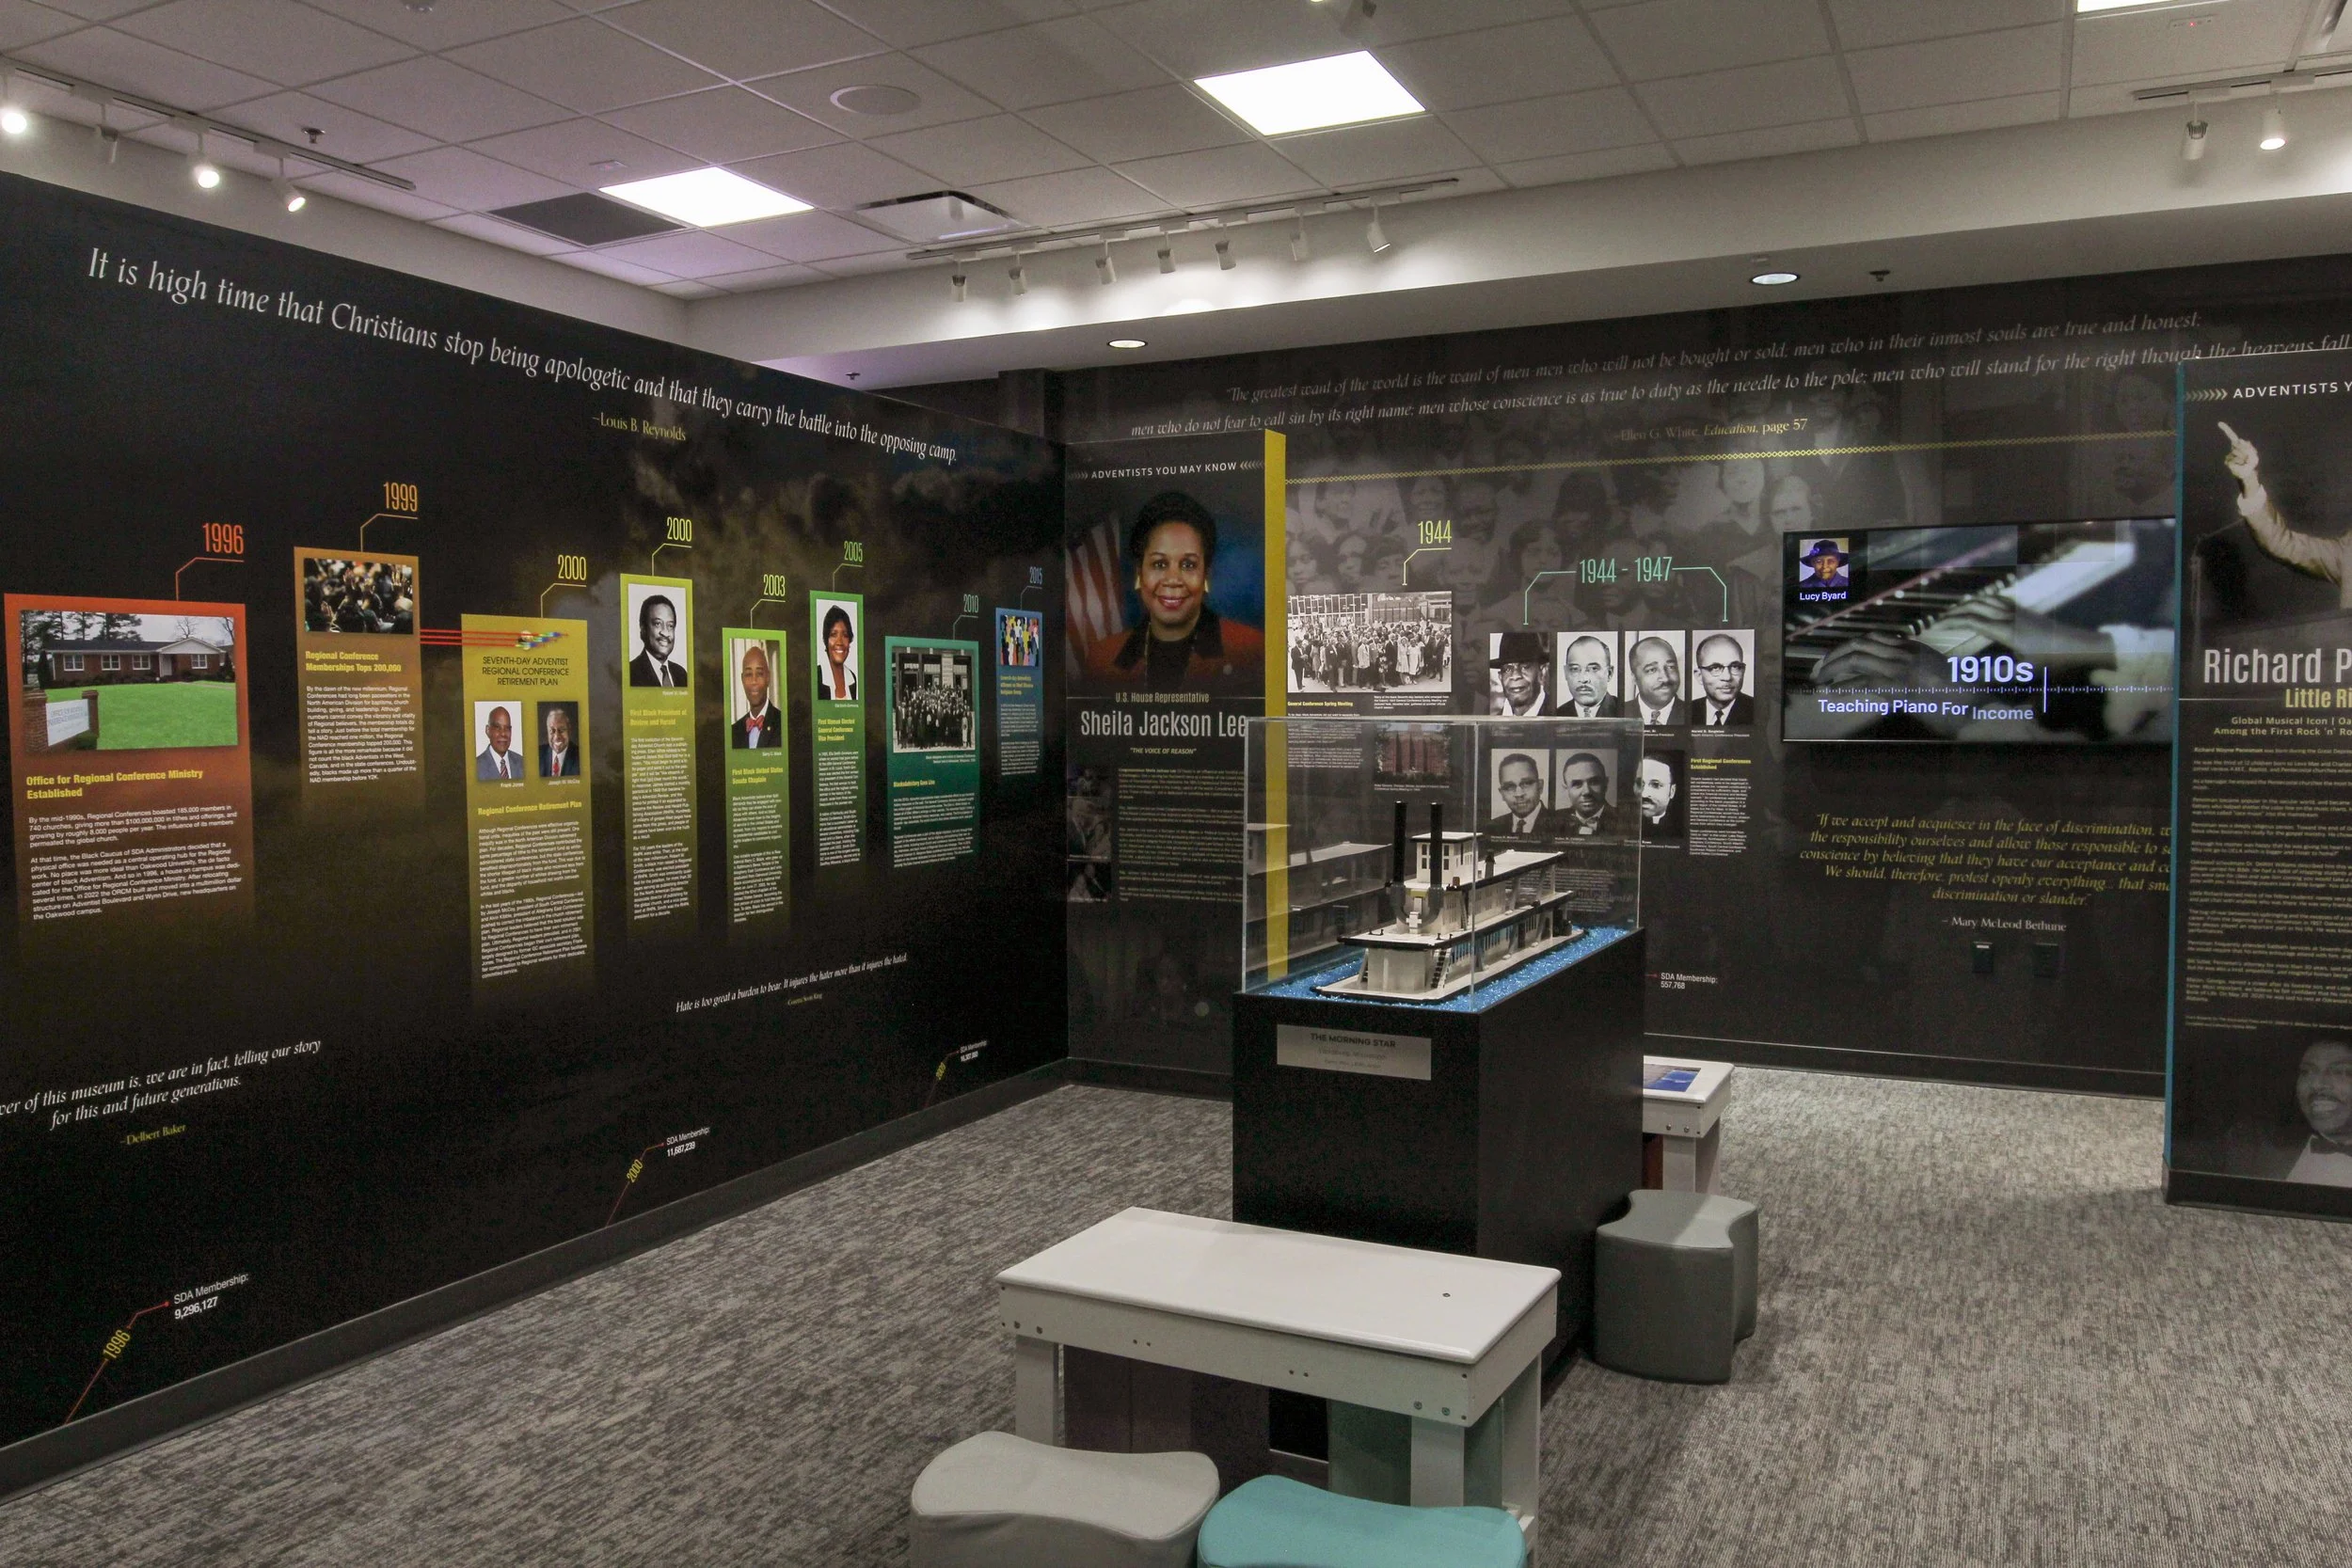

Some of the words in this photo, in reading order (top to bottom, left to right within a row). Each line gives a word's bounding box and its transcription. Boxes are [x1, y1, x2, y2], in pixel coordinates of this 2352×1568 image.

[88, 247, 109, 279] It
[119, 258, 138, 285] is
[149, 261, 207, 305] high
[217, 278, 269, 312] time
[278, 291, 325, 325] that
[331, 303, 437, 350] Christians
[444, 330, 484, 364] stop
[490, 338, 540, 377] being
[545, 357, 630, 391] apologetic
[634, 377, 665, 398] and
[670, 380, 698, 405] that
[702, 388, 733, 419] they
[736, 399, 772, 426] carry
[776, 404, 795, 427] the
[800, 409, 832, 436] battle
[835, 420, 857, 440] into
[860, 424, 878, 445] the
[881, 433, 927, 460] opposing
[930, 443, 957, 466] camp.
[2233, 382, 2338, 399] ADVENTISTS
[1131, 426, 1153, 436] men
[1158, 420, 1182, 435] who
[1185, 419, 1200, 432] do
[1202, 418, 1220, 431] not
[1223, 415, 1246, 433] fear
[1250, 415, 1261, 428] to
[1264, 411, 1285, 426] call
[1289, 412, 1304, 424] sin
[1310, 410, 1325, 426] by
[1328, 409, 1342, 421] its
[1345, 405, 1375, 422] right
[1419, 404, 1444, 414] men
[1449, 398, 1489, 413] whose
[1493, 392, 1563, 409] conscience
[1566, 391, 1576, 404] is
[1581, 392, 1596, 404] as
[1600, 388, 1627, 402] true
[1631, 386, 1645, 400] to
[1648, 383, 1681, 402] duty
[1686, 385, 1702, 396] as
[1707, 378, 1729, 394] the
[1734, 374, 1781, 392] needle
[1786, 375, 1800, 389] to
[1804, 372, 1828, 388] the
[630, 418, 640, 433] B.
[643, 420, 686, 441] Reynolds
[1762, 422, 1789, 436] page
[1793, 418, 1808, 431] 57
[1091, 467, 1152, 479] ADVENTISTS
[1156, 466, 1177, 476] YOU
[1180, 464, 1202, 474] MAY
[1205, 462, 1236, 472] KNOW
[383, 482, 419, 513] 1999
[202, 523, 245, 555] 1996
[666, 516, 692, 542] 2000
[1418, 519, 1453, 544] 1944
[844, 541, 864, 562] 2005
[557, 555, 587, 581] 2000
[1029, 566, 1042, 585] 2015
[1580, 559, 1616, 583] 1944
[1635, 557, 1673, 581] 1947
[763, 574, 787, 596] 2003
[963, 594, 979, 614] 2010
[1799, 592, 1820, 602] Lucy
[1821, 592, 1847, 602] Byard
[482, 666, 519, 675] REGIONAL
[521, 667, 568, 677] CONFERENCE
[483, 657, 531, 666] SEVENTH-DAY
[532, 657, 568, 666] ADVENTIST
[1947, 656, 2034, 683] 1910s
[2203, 648, 2322, 684] Richard
[497, 677, 538, 686] RETIREMENT
[540, 677, 559, 686] PLAN
[1116, 692, 1129, 703] U.S.
[1131, 692, 1153, 704] House
[1155, 692, 1210, 704] Representative
[2285, 688, 2331, 708] Little
[1818, 699, 1889, 715] Teaching
[1893, 700, 1938, 714] Piano
[1942, 702, 1968, 716] For
[1972, 705, 2034, 721] Income
[1081, 710, 1133, 736] Sheila
[1139, 711, 1212, 737] Jackson
[1219, 711, 1247, 737] Lee
[2232, 717, 2262, 725] Global
[2265, 717, 2303, 725] Musical
[2307, 717, 2328, 725] Icon
[2214, 728, 2247, 736] Among
[26, 775, 55, 786] Office
[57, 774, 72, 784] for
[73, 773, 114, 785] Regional
[117, 770, 166, 783] Conference
[168, 768, 203, 781] Ministry
[26, 788, 83, 800] Established
[1951, 917, 1976, 929] Mary
[1981, 918, 2022, 929] McLeod
[2026, 920, 2066, 931] Bethune
[1677, 973, 1718, 984] Membership:
[1311, 1033, 1327, 1041] THE
[1328, 1037, 1371, 1046] MORNING
[1374, 1038, 1396, 1048] STAR
[24, 1092, 40, 1114] of
[43, 1091, 66, 1106] this
[72, 1079, 124, 1101] museum
[146, 1071, 166, 1085] we
[167, 1067, 188, 1081] are
[192, 1063, 203, 1075] in
[234, 1048, 269, 1068] telling
[271, 1044, 292, 1060] our
[294, 1039, 322, 1055] story
[51, 1110, 72, 1131] for
[75, 1105, 98, 1121] this
[103, 1099, 128, 1116] and
[131, 1091, 167, 1113] future
[171, 1075, 241, 1103] generations.
[667, 1136, 677, 1146] SDA
[679, 1127, 709, 1141] Membership:
[627, 1159, 644, 1182] 2000
[173, 1290, 194, 1305] SDA
[196, 1274, 248, 1298] Membership:
[175, 1296, 218, 1320] 9,296,127
[103, 1329, 131, 1359] 1996
